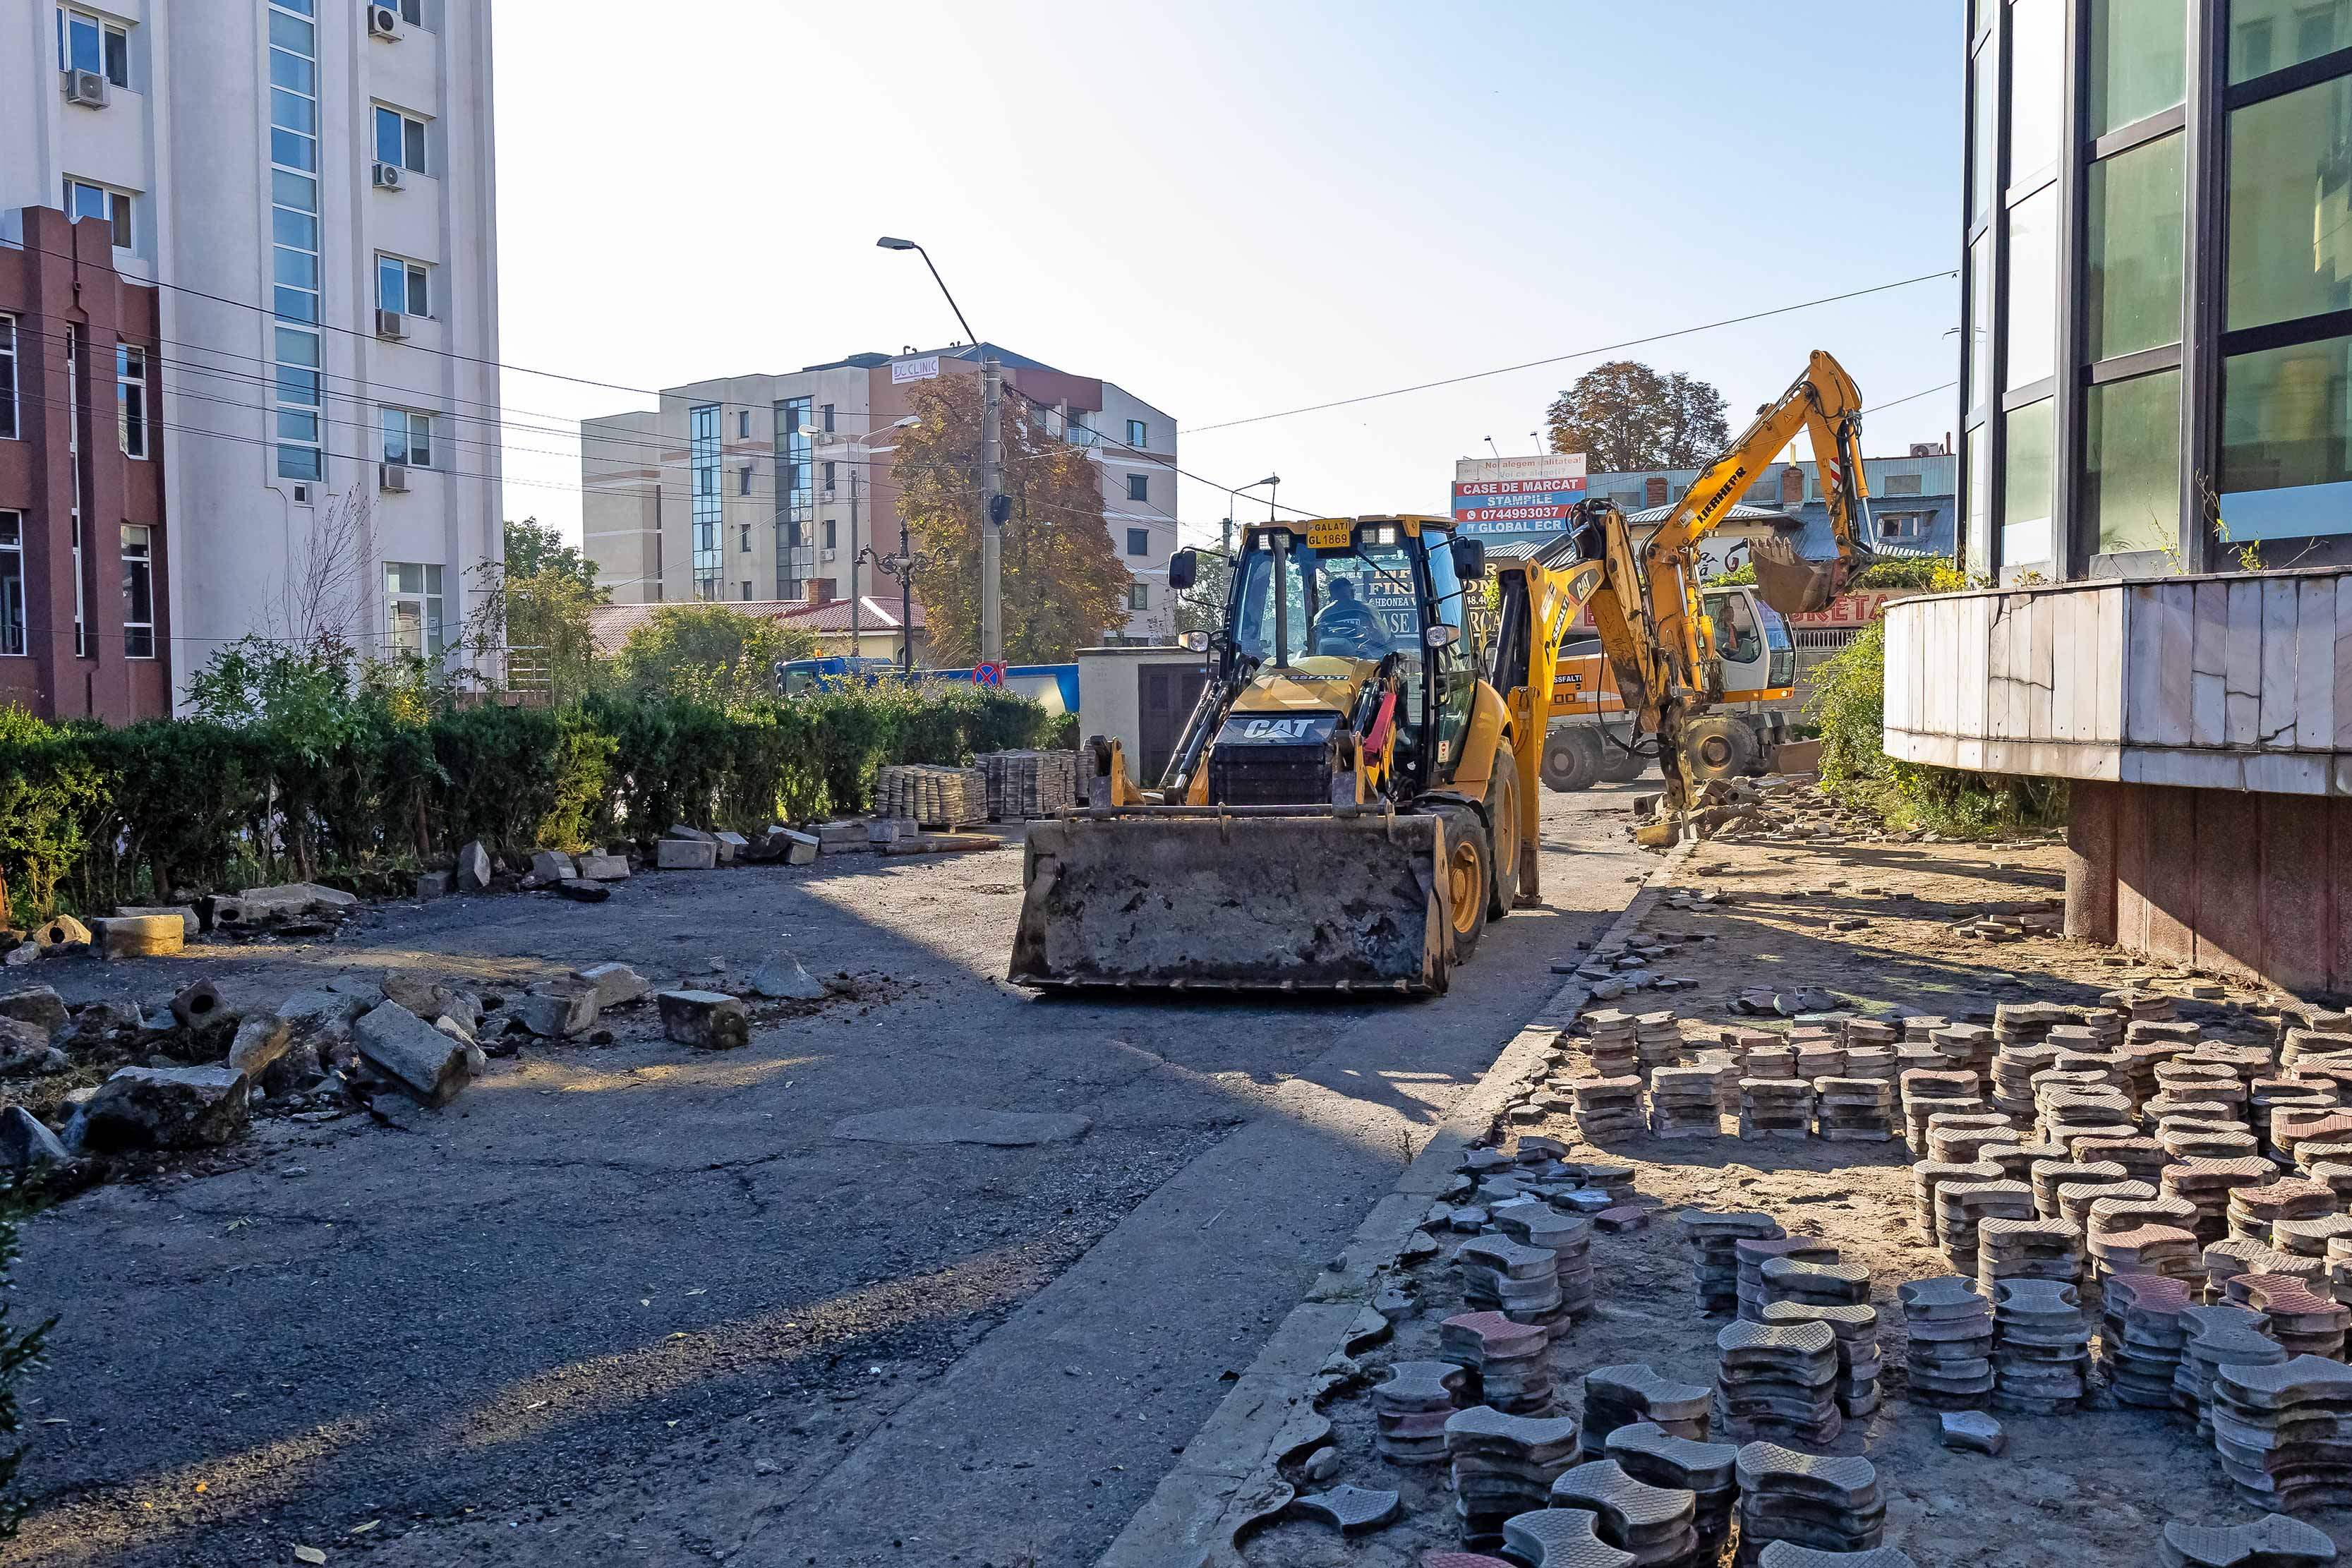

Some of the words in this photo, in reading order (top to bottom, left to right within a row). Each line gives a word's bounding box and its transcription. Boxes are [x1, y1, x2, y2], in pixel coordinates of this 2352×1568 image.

[907, 360, 937, 375] CLINIC
[1502, 460, 1536, 469] alegem
[1463, 483, 1497, 495] CASE
[1501, 483, 1519, 493] DE
[1522, 479, 1579, 492] MARCAT
[1696, 466, 1747, 524] LIEBHERR
[1481, 507, 1559, 520] 0744993037
[1315, 522, 1348, 531] GALATI
[1478, 521, 1531, 533] GLOBAL
[1535, 520, 1562, 531] ECR
[1309, 536, 1321, 545] GL
[1323, 533, 1347, 545] 1869
[1576, 572, 1591, 601] CAT
[1243, 719, 1315, 738] CAT
